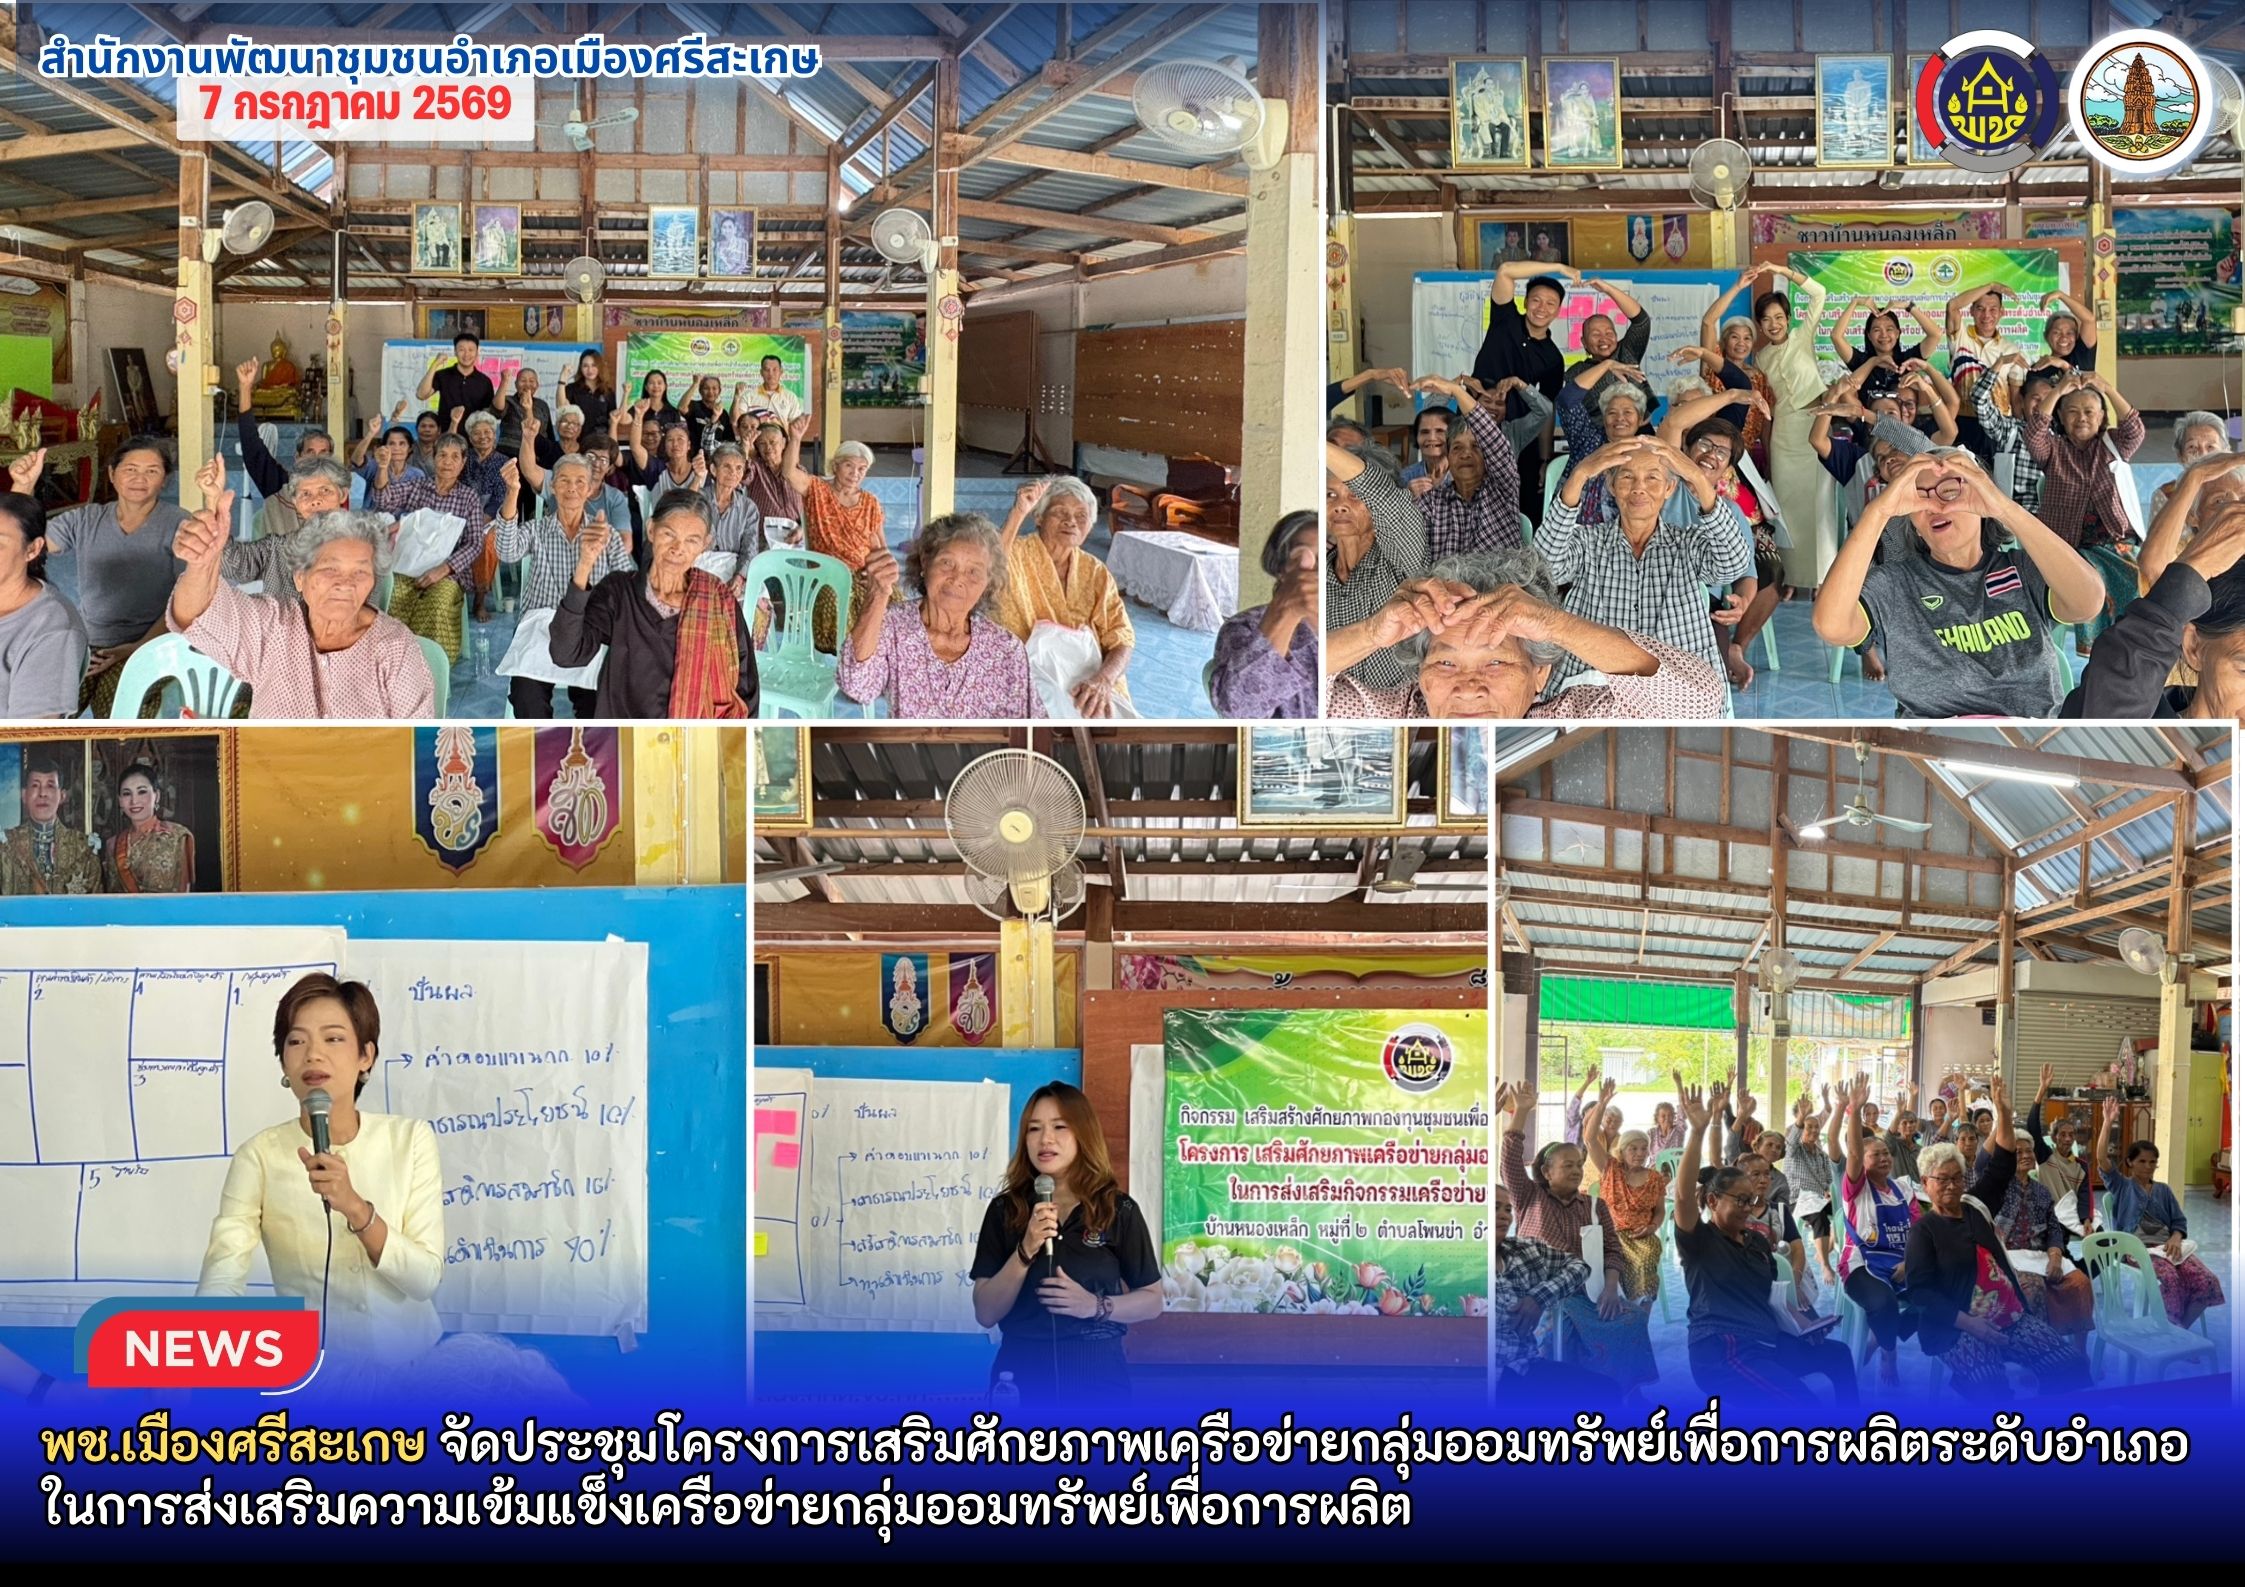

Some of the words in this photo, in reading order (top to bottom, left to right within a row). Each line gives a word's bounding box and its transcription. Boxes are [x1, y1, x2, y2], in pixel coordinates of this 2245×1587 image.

[427, 1085, 590, 1135] าธารณประโยชน์
[1180, 1104, 1235, 1126] กิจกรรม
[1245, 1102, 1488, 1133] เสริมสร้างศักยภาพกองทุนชุมชนเพื่อ
[1179, 1139, 1249, 1164] โครงการ
[1230, 1177, 1488, 1203] ในการส่งเสริมกิจกรรมเครือข่าย
[1205, 1216, 1309, 1239] บ้านหนองเหล็ก
[1318, 1213, 1351, 1245] หมู่ที่
[1377, 1218, 1464, 1240] ตำบลโพนข่า
